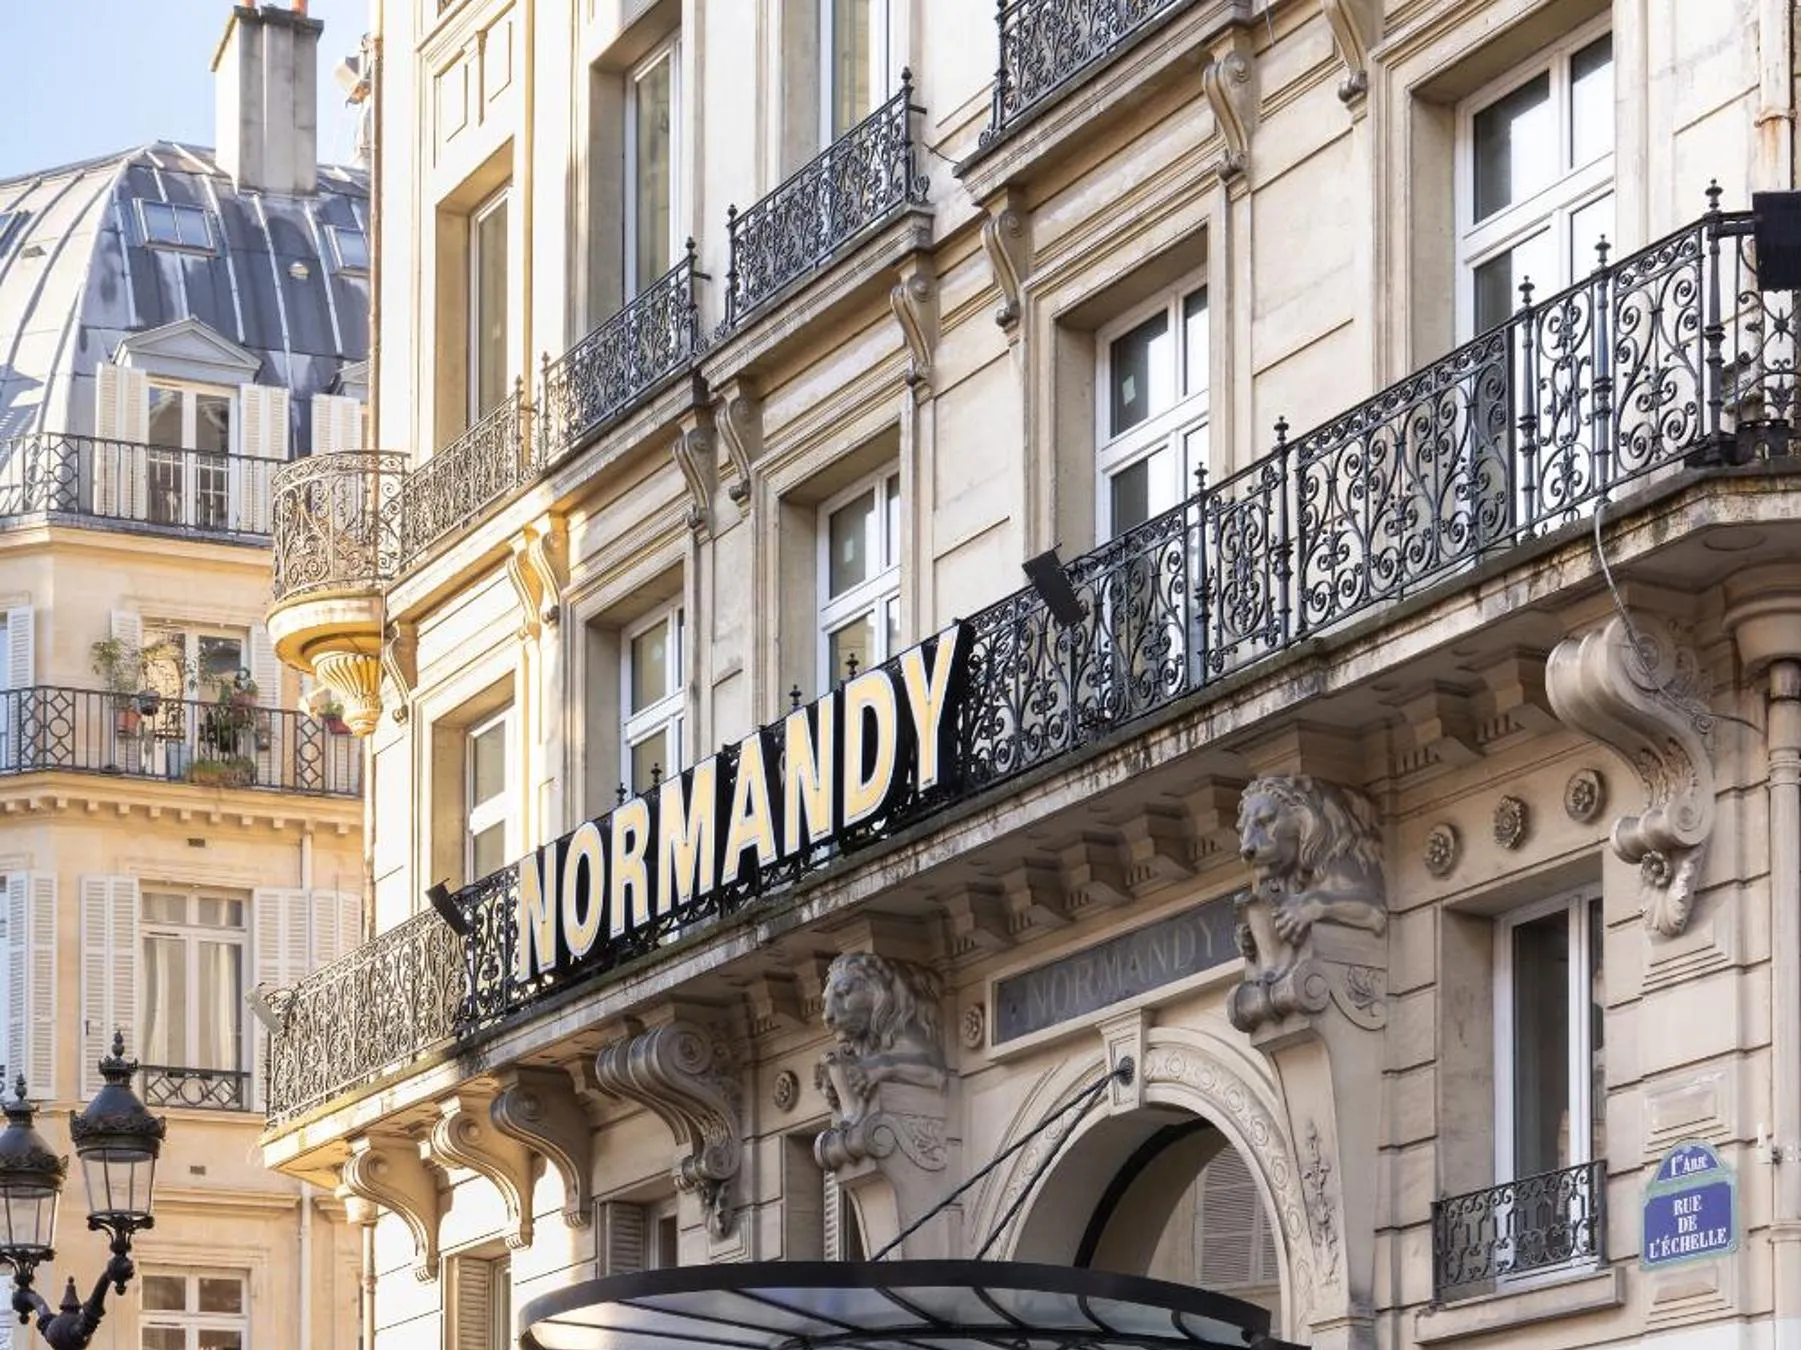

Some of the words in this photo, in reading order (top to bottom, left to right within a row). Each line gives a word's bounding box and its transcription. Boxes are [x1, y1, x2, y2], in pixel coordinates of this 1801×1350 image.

[516, 625, 961, 984] NORMANDY
[1026, 915, 1218, 1029] NORMANDY
[1673, 1195, 1702, 1216] RUE
[1678, 1214, 1698, 1234] DE
[1649, 1228, 1727, 1259] L'ÉCHELLE
